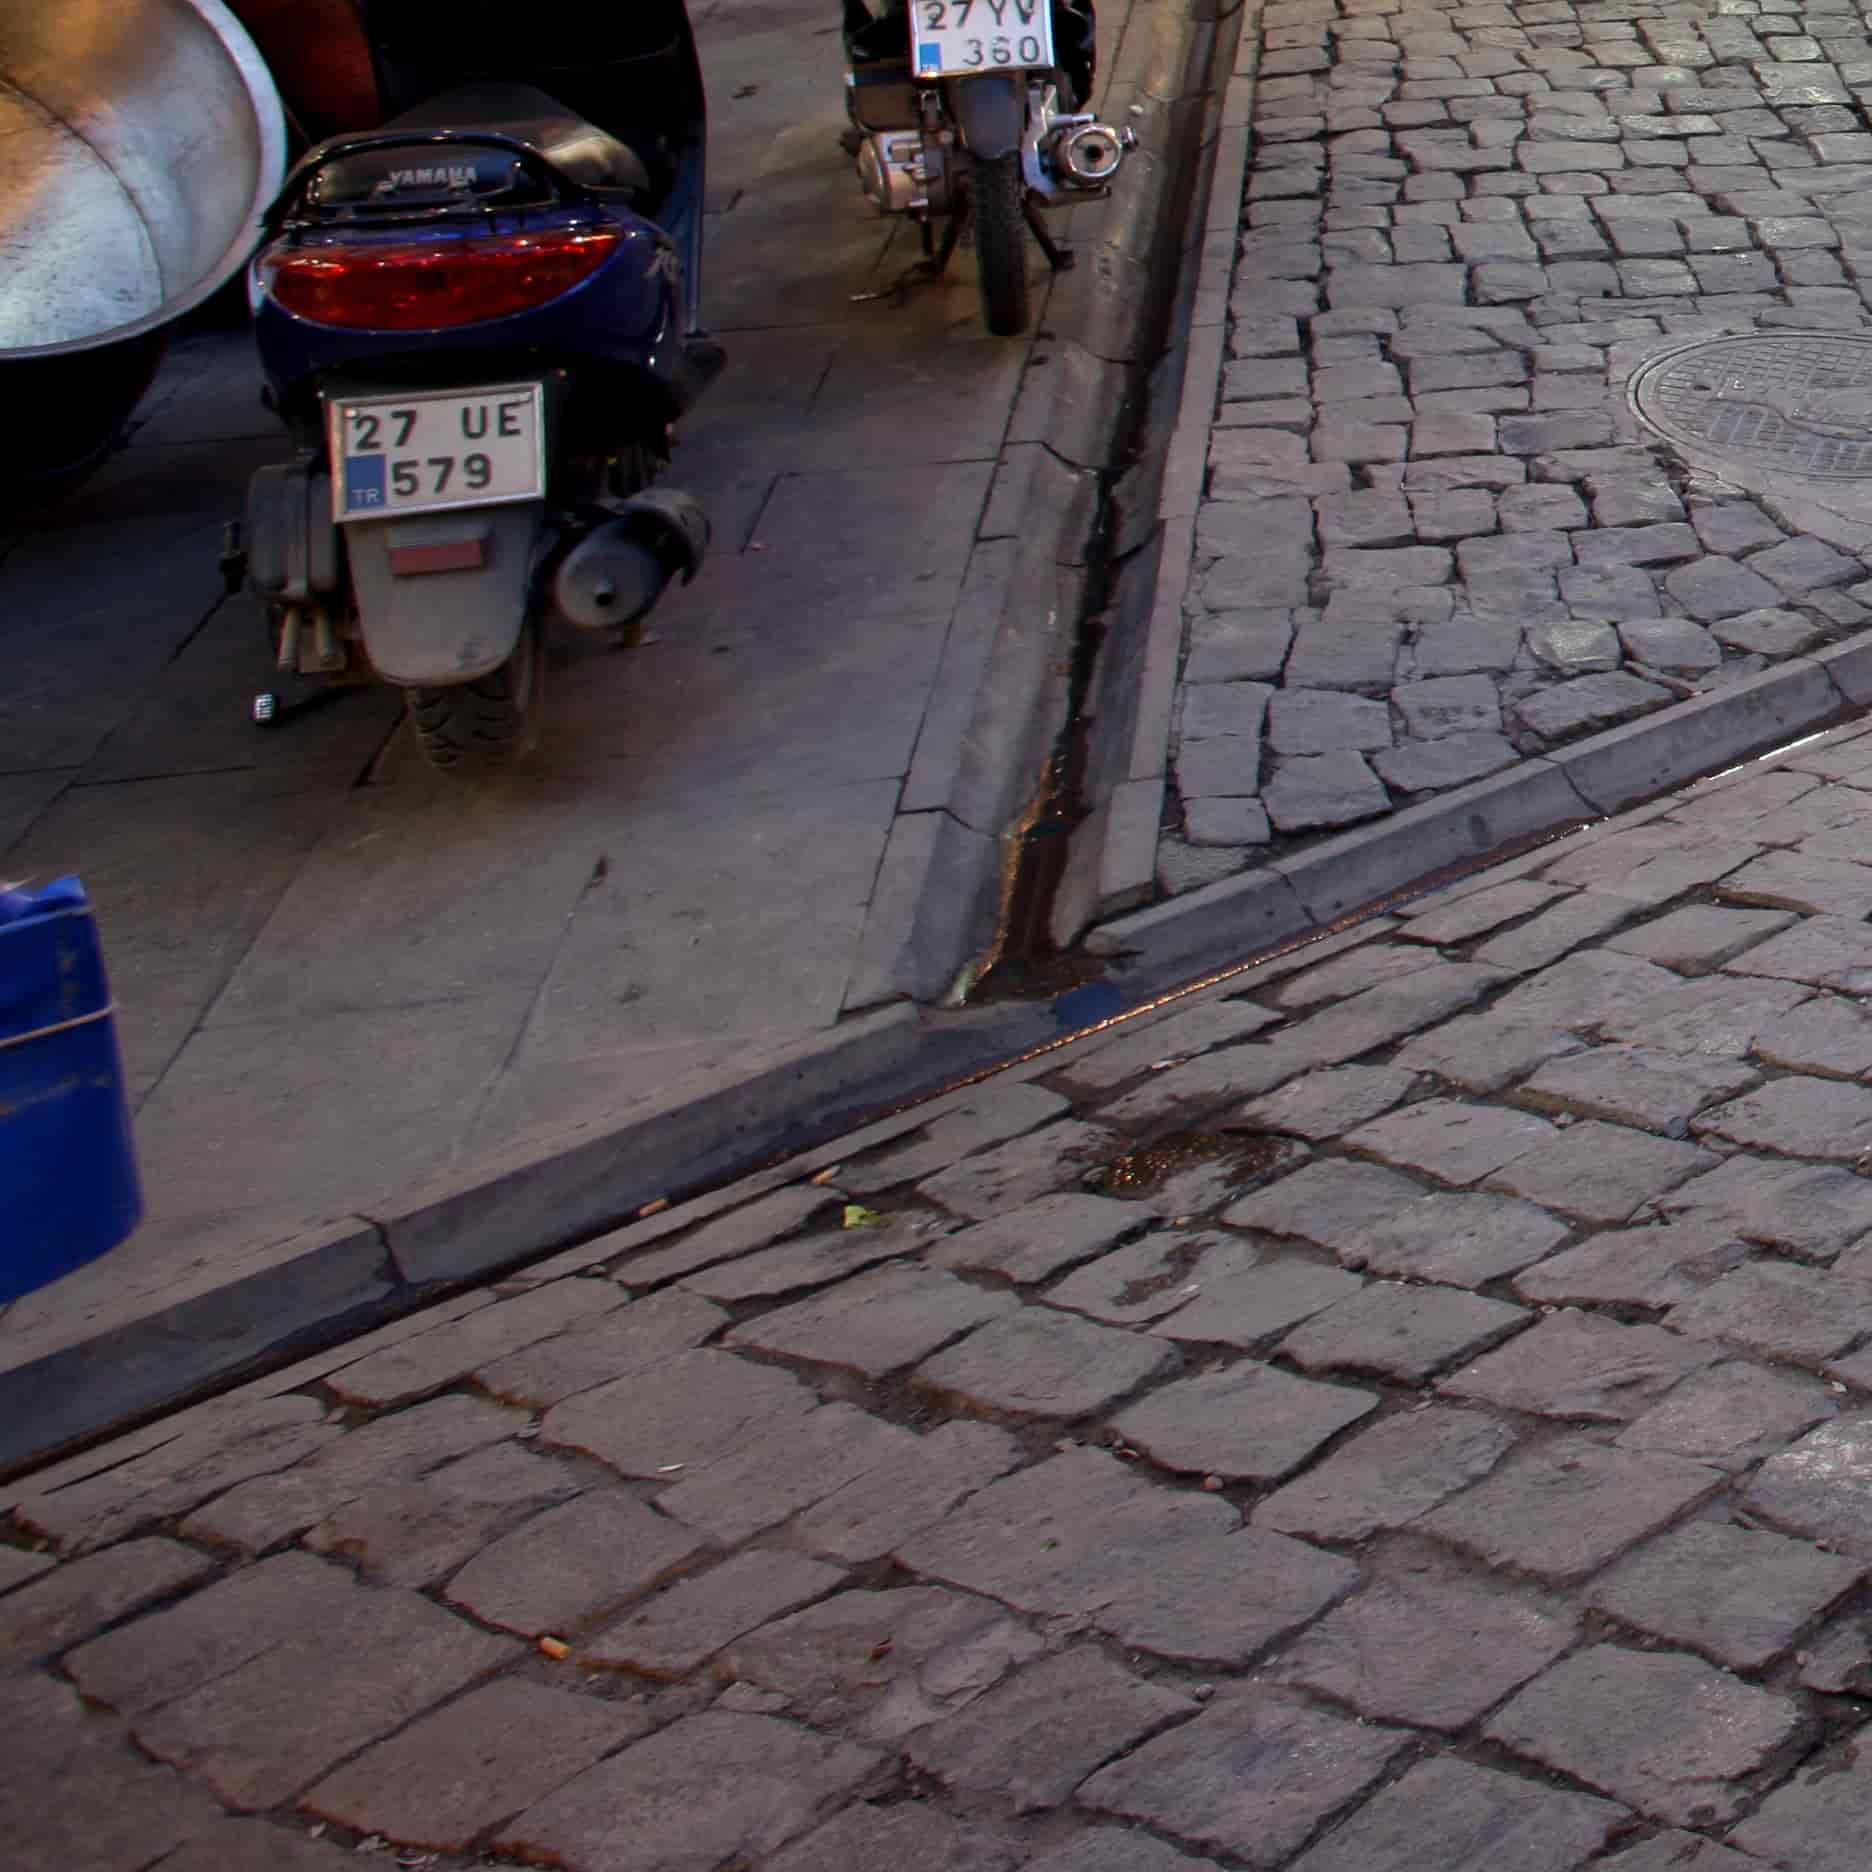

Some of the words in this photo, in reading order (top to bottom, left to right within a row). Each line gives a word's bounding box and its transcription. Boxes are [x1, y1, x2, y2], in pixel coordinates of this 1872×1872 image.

[963, 34, 1040, 66] 360
[388, 167, 478, 186] YAMAHA
[354, 408, 419, 451] 27
[460, 400, 523, 440] UE
[391, 452, 493, 498] 579
[351, 488, 380, 506] TR
